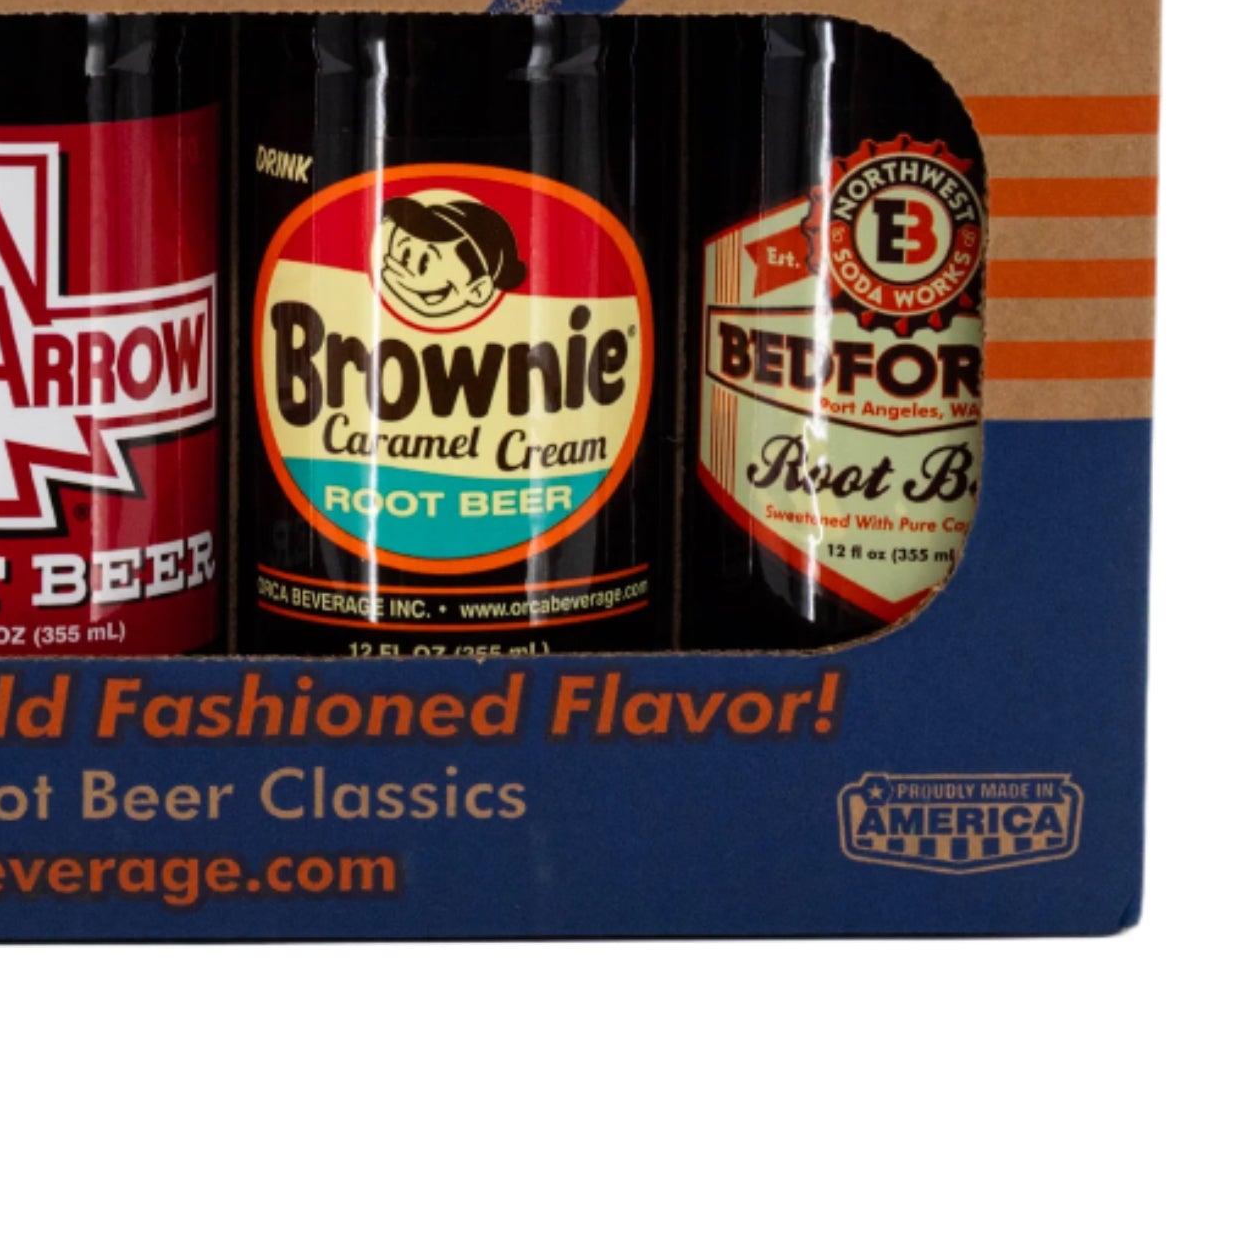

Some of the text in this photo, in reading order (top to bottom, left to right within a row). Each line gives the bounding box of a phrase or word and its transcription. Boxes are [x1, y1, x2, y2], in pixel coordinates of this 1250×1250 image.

[255, 144, 313, 184] DRINK
[833, 160, 976, 221] NORTHWEST
[766, 246, 801, 269] Est.
[832, 249, 971, 309] SODA WORKS
[861, 401, 945, 421] Angeles,
[323, 411, 608, 473] Caramel Cream
[746, 434, 894, 500] Root
[324, 485, 573, 518] ROOT BEER
[765, 505, 850, 528] Sweetened
[855, 514, 894, 531] With
[900, 517, 936, 533] Pure
[32, 529, 217, 608] BEER
[827, 544, 846, 558] 12
[851, 544, 862, 559] fl
[867, 549, 886, 561] oz
[892, 547, 928, 564] (355
[291, 587, 385, 617] BEVERAGE
[390, 598, 431, 619] INC.
[459, 579, 649, 619] www.orcabeverage.com
[33, 624, 81, 648] (355
[87, 620, 126, 642] mL)
[97, 672, 525, 739] Fashioned
[551, 672, 844, 737] Flavor!
[82, 768, 235, 821] Beer
[260, 766, 527, 821] Classics
[897, 782, 1054, 799] PROUDLY MADE IN
[856, 805, 1064, 836] AMERICA
